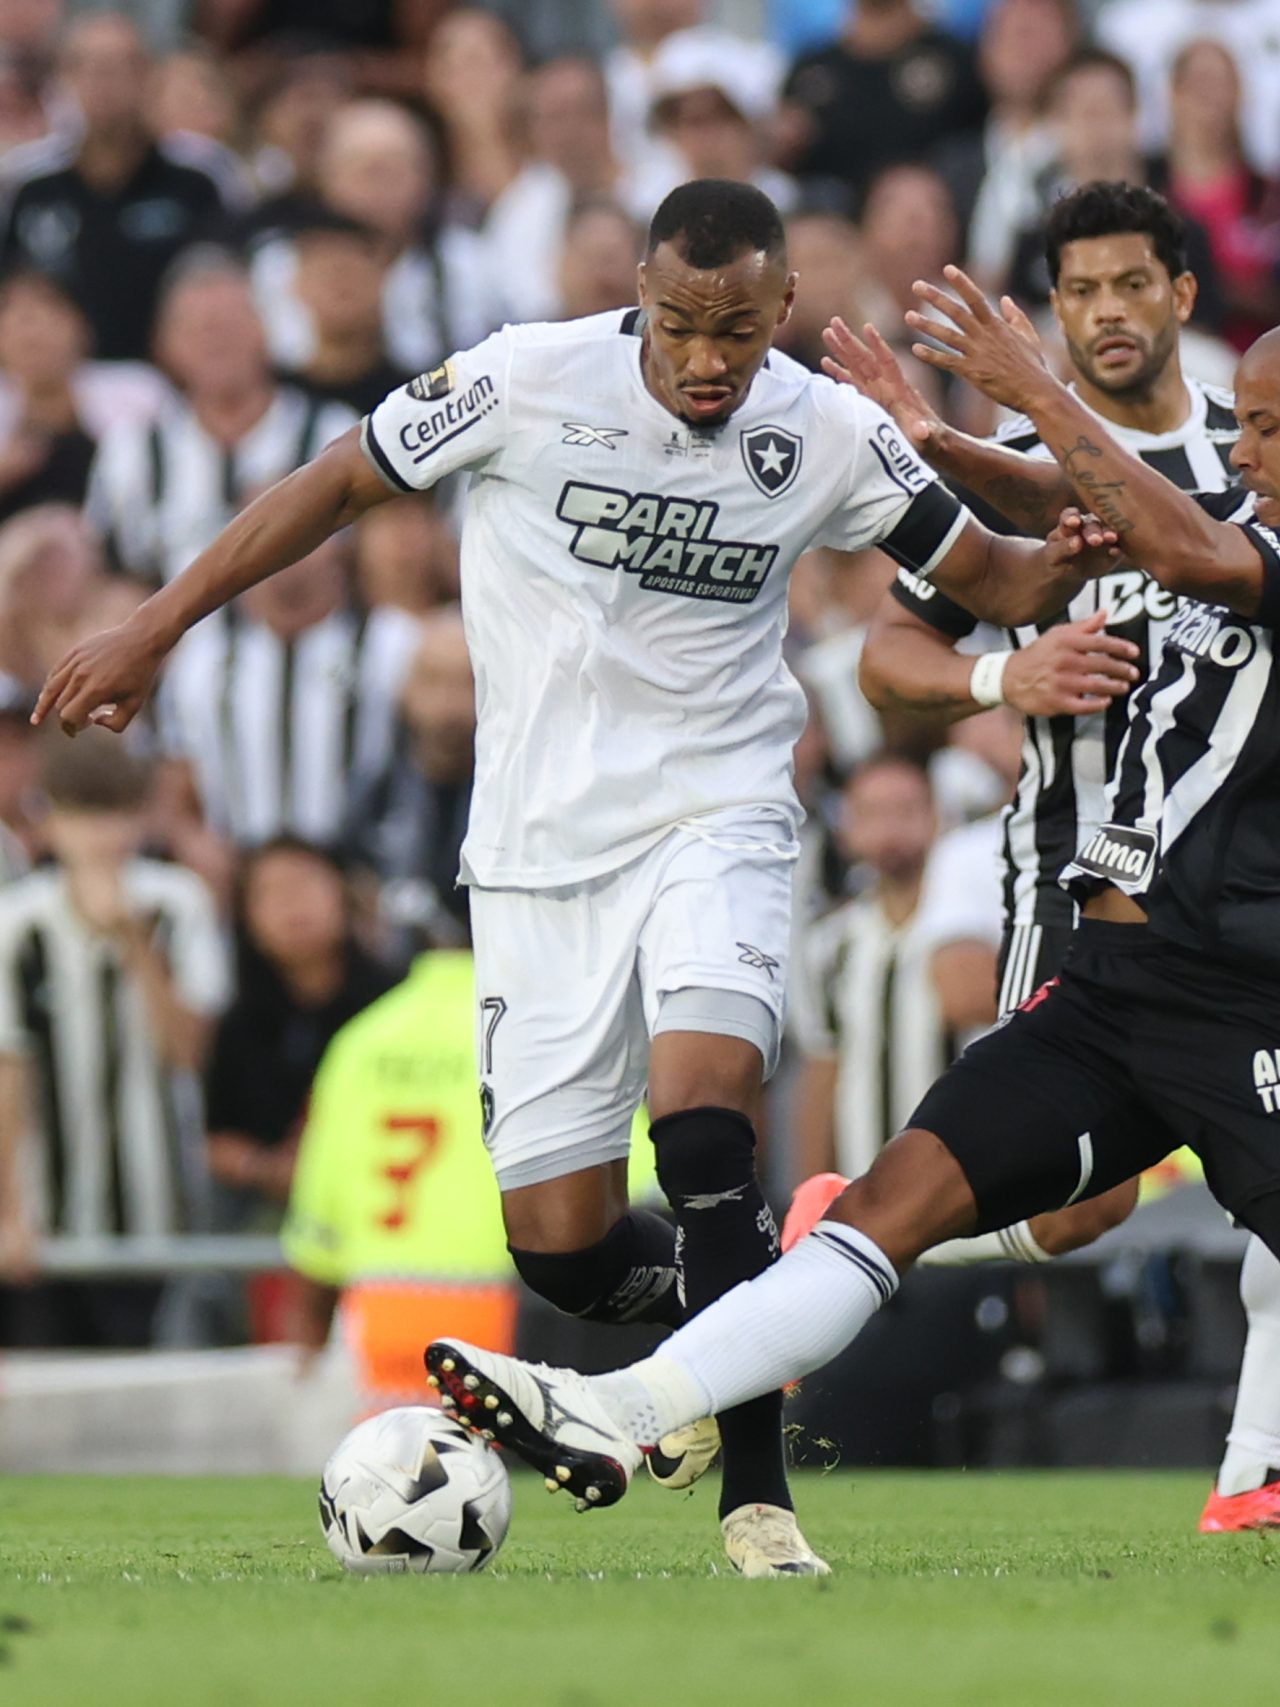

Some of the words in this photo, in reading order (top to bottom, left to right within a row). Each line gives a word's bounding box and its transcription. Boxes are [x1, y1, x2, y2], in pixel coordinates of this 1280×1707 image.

[399, 375, 494, 452] Centrum
[877, 423, 930, 487] Centr
[558, 482, 717, 541] PARI
[573, 525, 775, 582] MATCH
[644, 574, 694, 593] APOSTAS
[1081, 828, 1148, 877] ilma
